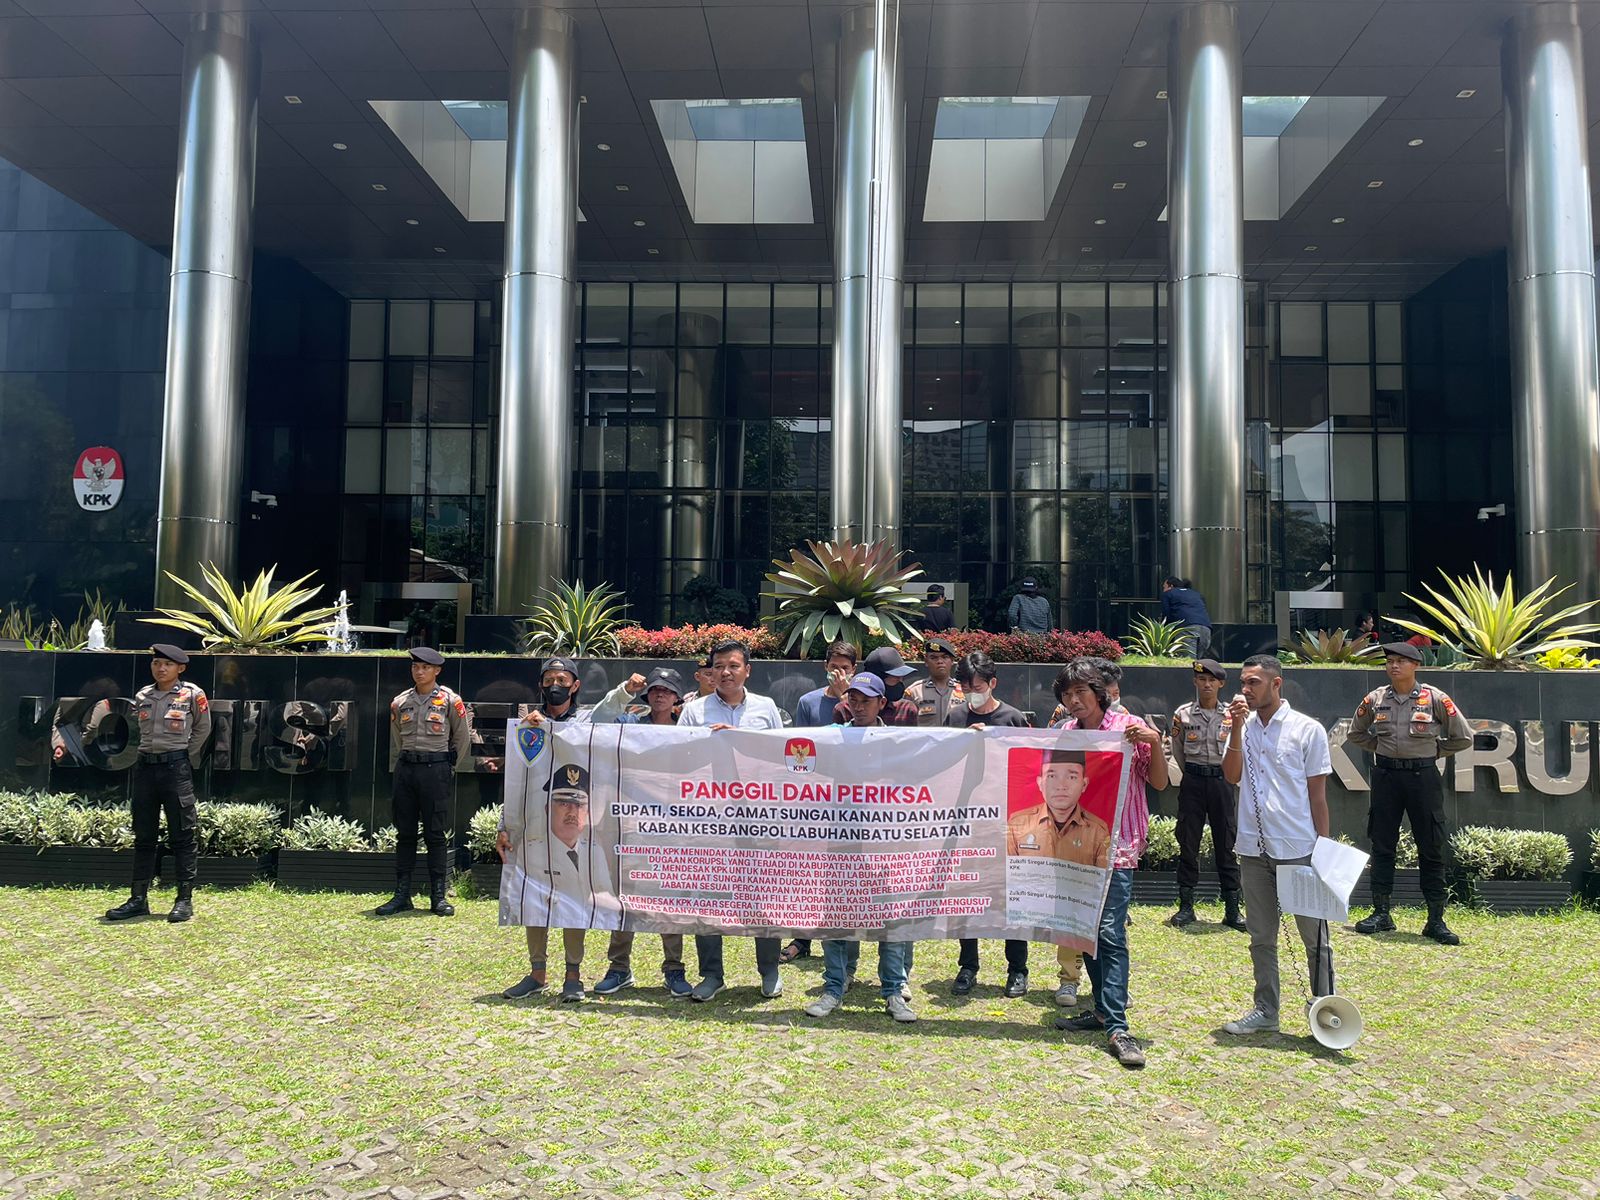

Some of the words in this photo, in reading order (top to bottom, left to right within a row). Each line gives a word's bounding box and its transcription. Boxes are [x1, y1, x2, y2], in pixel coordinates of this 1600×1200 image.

[84, 494, 112, 506] KPK
[681, 782, 778, 801] PANGGIL
[784, 784, 832, 802] DAN
[838, 785, 933, 804] PERIKSA
[612, 804, 666, 818] BUPATI,
[670, 805, 721, 819] SEKDA,
[725, 807, 778, 820] CAMAT
[781, 808, 835, 822] SUNGAI
[839, 810, 896, 823] KANAN
[897, 810, 930, 823] DAN
[933, 807, 999, 822] MANTAN
[639, 822, 689, 834] KABAN
[693, 823, 787, 837] KESBANGPOL
[791, 827, 901, 840] LABUHANBATU
[905, 825, 970, 839] SELATAN
[681, 848, 727, 857] MENINDAK
[728, 850, 763, 858] LANJUTI
[765, 851, 804, 860] LAPORAN
[807, 853, 866, 861] MASYARAKAT
[869, 853, 910, 861] TENTANG
[912, 851, 948, 860] ADANYA
[950, 849, 995, 857] BERBAGAI
[649, 856, 686, 864] DUGAAN
[728, 858, 750, 866] YANG
[752, 859, 786, 868] TERJADI
[800, 862, 851, 870] KABUPATEN
[854, 861, 919, 870] LABUHANBATU
[921, 859, 960, 867] SELATAN
[662, 865, 710, 873] MENDESAK
[729, 867, 759, 875] UNTUK
[760, 868, 812, 877] MEMERIKSA
[814, 871, 845, 879] BUPATI
[847, 869, 912, 879] LABUHANBATU
[915, 866, 953, 875] SELATAN
[680, 873, 711, 881] CAMAT
[713, 875, 746, 883] SUNGAI
[748, 876, 777, 885] KANAN
[779, 878, 817, 886] DUGAAN
[860, 876, 914, 887] GRATIFIKASI
[916, 875, 934, 883] DAN
[936, 874, 959, 882] JUAL
[960, 873, 978, 881] BELI
[661, 882, 698, 890] JABATAN
[700, 882, 730, 891] SESUAI
[732, 884, 789, 894] PERCAKAPAN
[871, 885, 912, 895] BEREDAR
[913, 883, 945, 891] DALAM
[628, 896, 675, 906] MENDESAK
[676, 899, 693, 907] KPK
[693, 900, 718, 908] AGAR
[719, 901, 752, 909] SEGERA
[754, 902, 784, 911] TURUN
[868, 902, 905, 911] SELATAN
[908, 900, 938, 909] UNTUK
[940, 898, 991, 907] MENGUSUT
[790, 896, 831, 904] LAPORAN
[663, 906, 697, 914] ADANYA
[699, 909, 741, 917] BERBAGAI
[743, 911, 781, 919] DUGAAN
[783, 912, 820, 920] KORUPSI
[849, 911, 899, 920] DILAKUKAN
[926, 907, 983, 916] PEMERINTAH
[722, 918, 774, 926] KABUPATEN
[776, 919, 840, 927] LABUHANBATU
